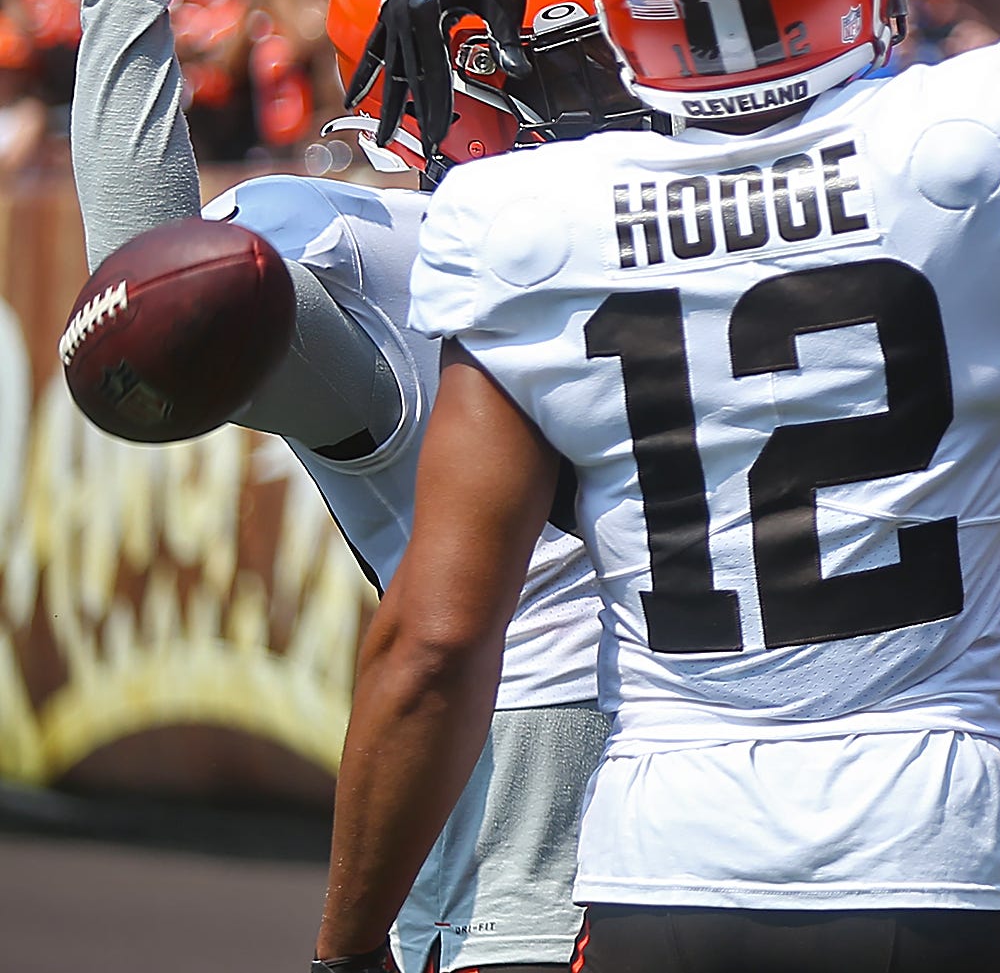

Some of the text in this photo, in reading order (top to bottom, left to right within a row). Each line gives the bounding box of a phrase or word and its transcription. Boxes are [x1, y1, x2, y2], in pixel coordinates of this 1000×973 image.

[681, 79, 808, 116] CLEVELAND
[613, 140, 869, 268] HODGE
[583, 258, 964, 653] 12
[455, 921, 497, 935] DRI-FIT
